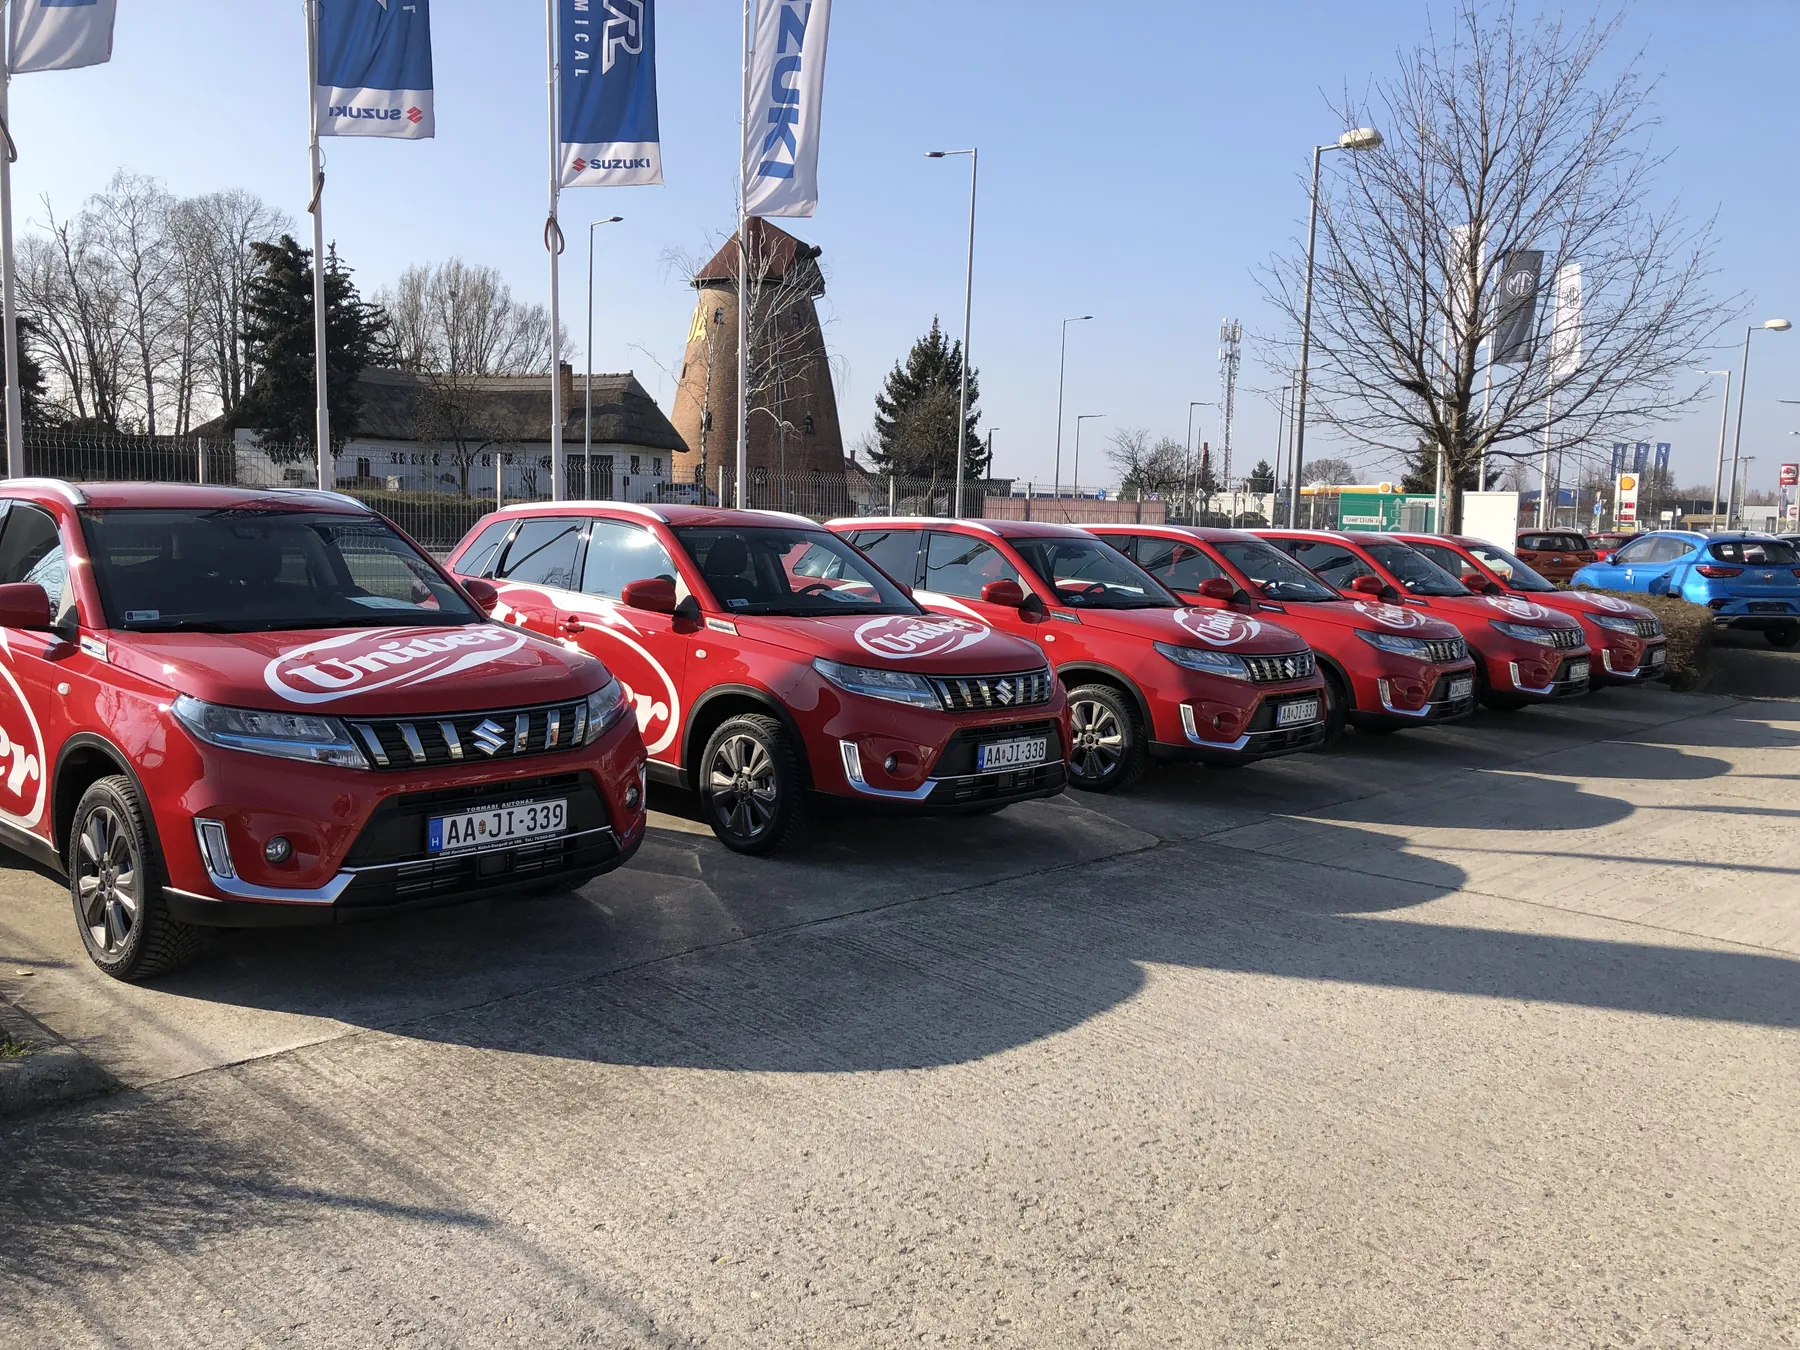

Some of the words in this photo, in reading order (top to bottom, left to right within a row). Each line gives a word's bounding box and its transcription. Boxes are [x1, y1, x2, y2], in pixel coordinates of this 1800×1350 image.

[590, 158, 651, 170] SUZUKI
[284, 628, 506, 688] Univer
[985, 747, 1001, 766] AA
[1006, 741, 1045, 762] JI-338
[431, 836, 439, 847] H
[446, 816, 476, 846] AA
[488, 803, 564, 838] JI-339
